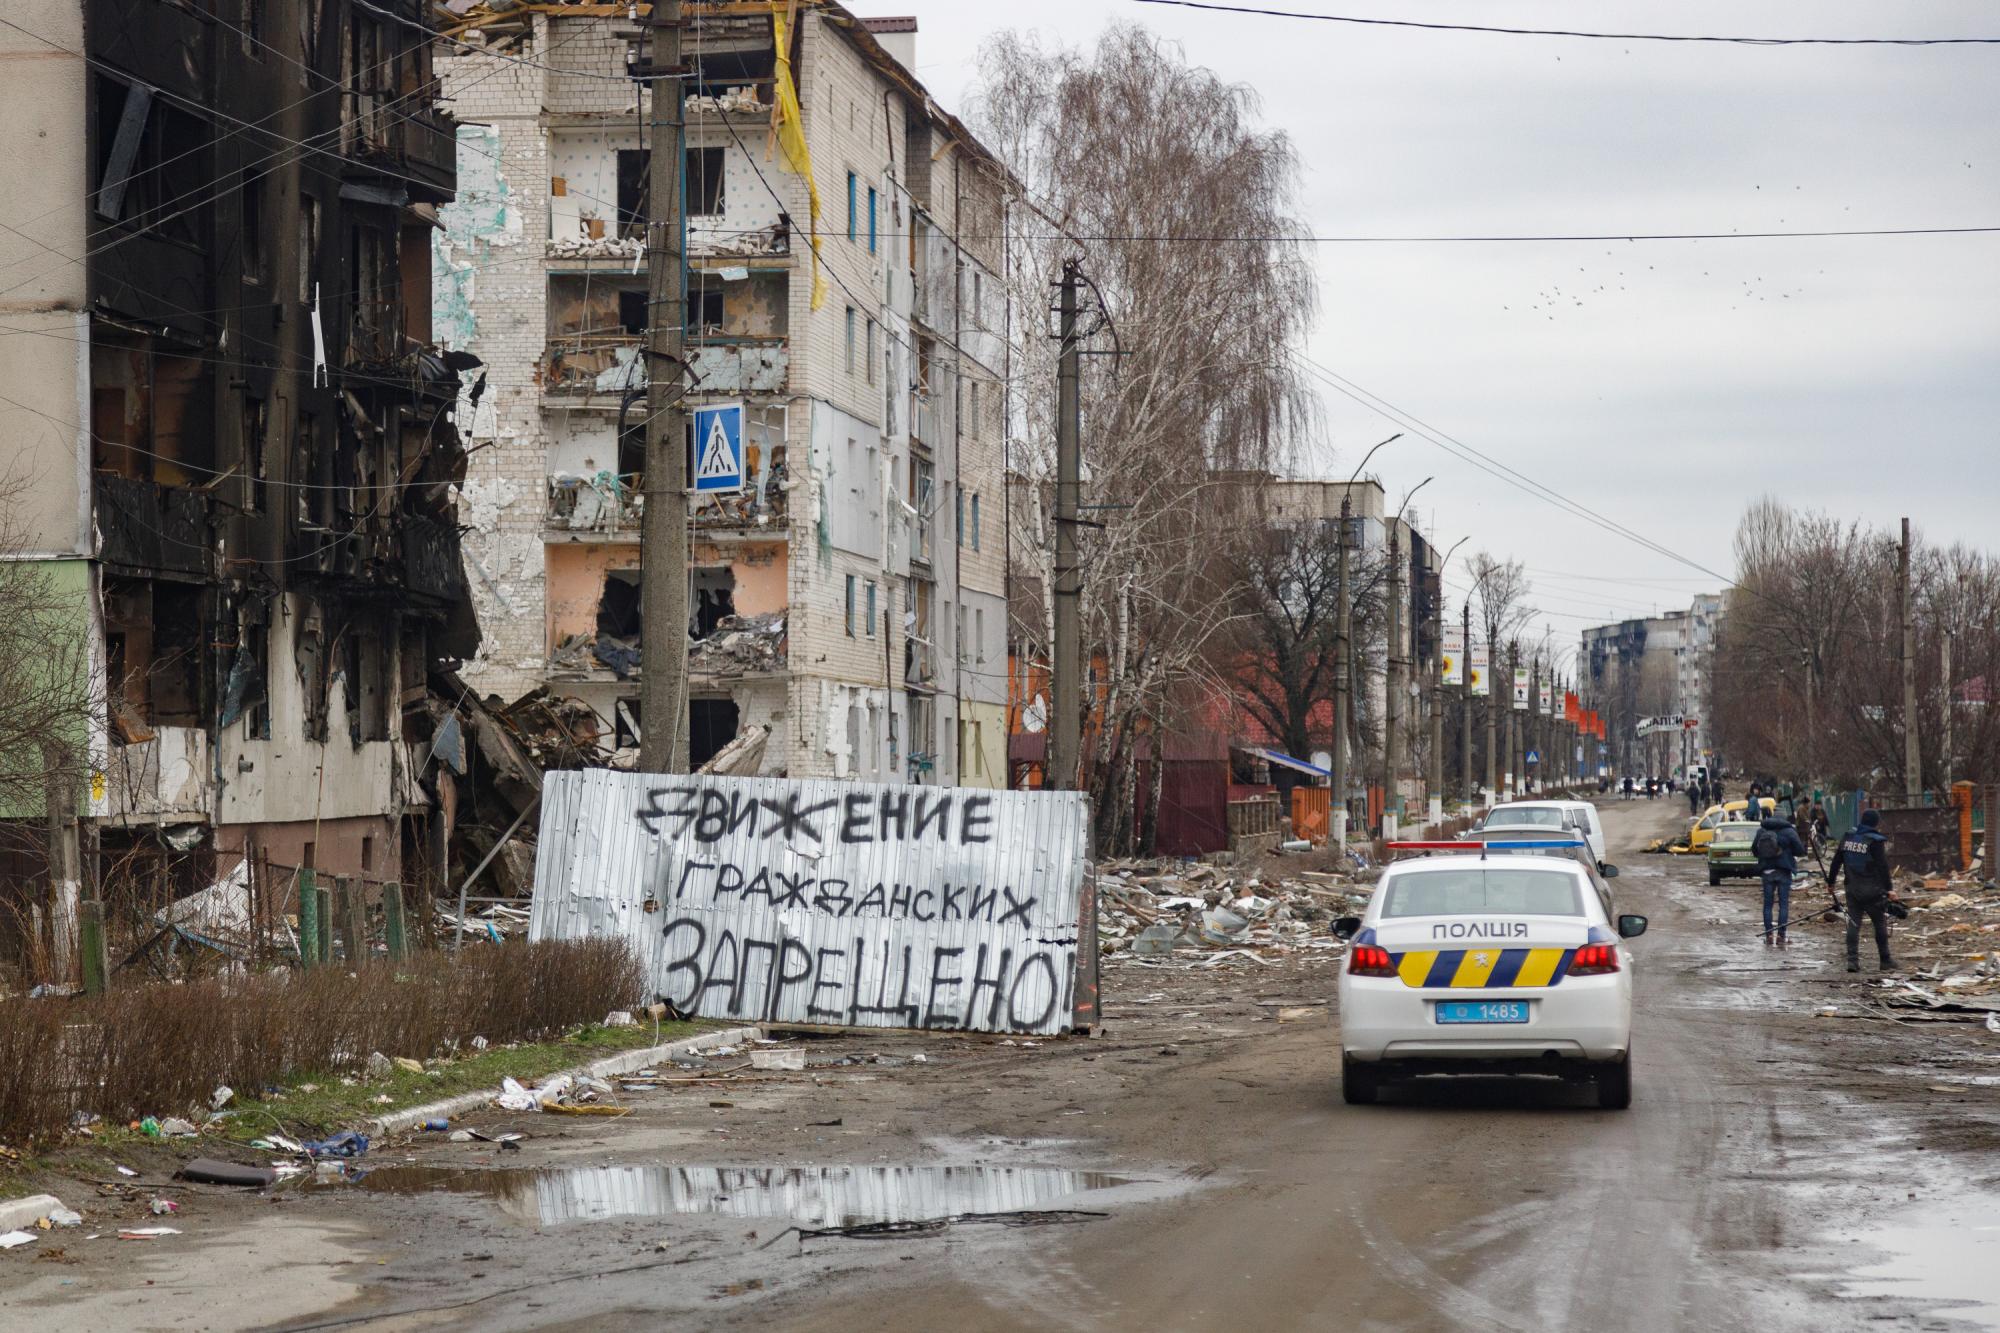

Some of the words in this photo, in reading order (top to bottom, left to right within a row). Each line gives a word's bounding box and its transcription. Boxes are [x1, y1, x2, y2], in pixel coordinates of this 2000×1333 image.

[635, 788, 992, 845] ДВИЖЕНИЕ
[1844, 840, 1868, 854] PRESS
[675, 860, 1037, 930] ГРАЖДАНСКИХ
[1432, 922, 1529, 940] ПОЛІЦІЯ
[662, 917, 1076, 1035] ЗАПРЕЩЕНО!
[1480, 1004, 1519, 1019] 1485
